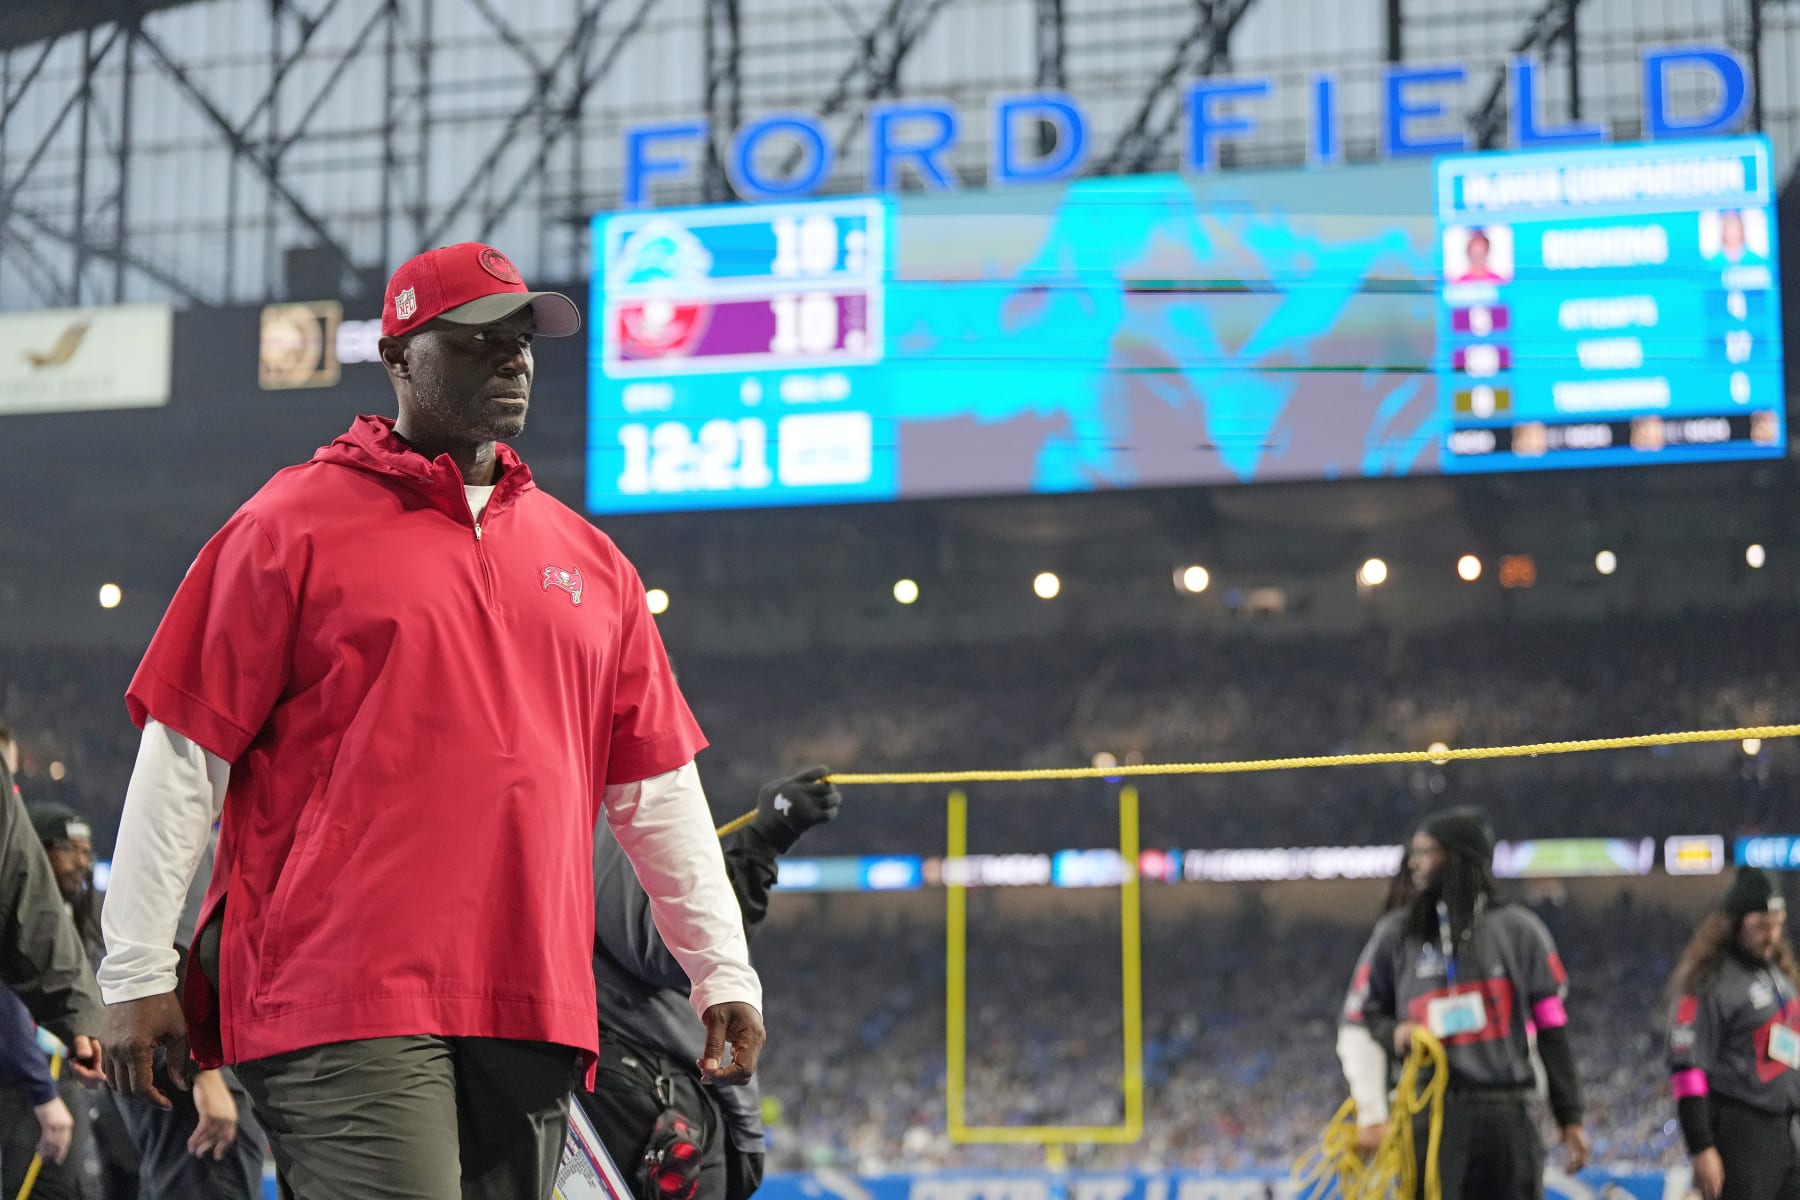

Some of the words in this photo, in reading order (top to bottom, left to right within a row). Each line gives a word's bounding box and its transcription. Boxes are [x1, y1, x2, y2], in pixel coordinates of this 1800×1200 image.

[625, 94, 1089, 206] FORD
[1186, 46, 1750, 169] FIELD
[400, 301, 414, 315] NFL
[617, 416, 772, 494] 12:21
